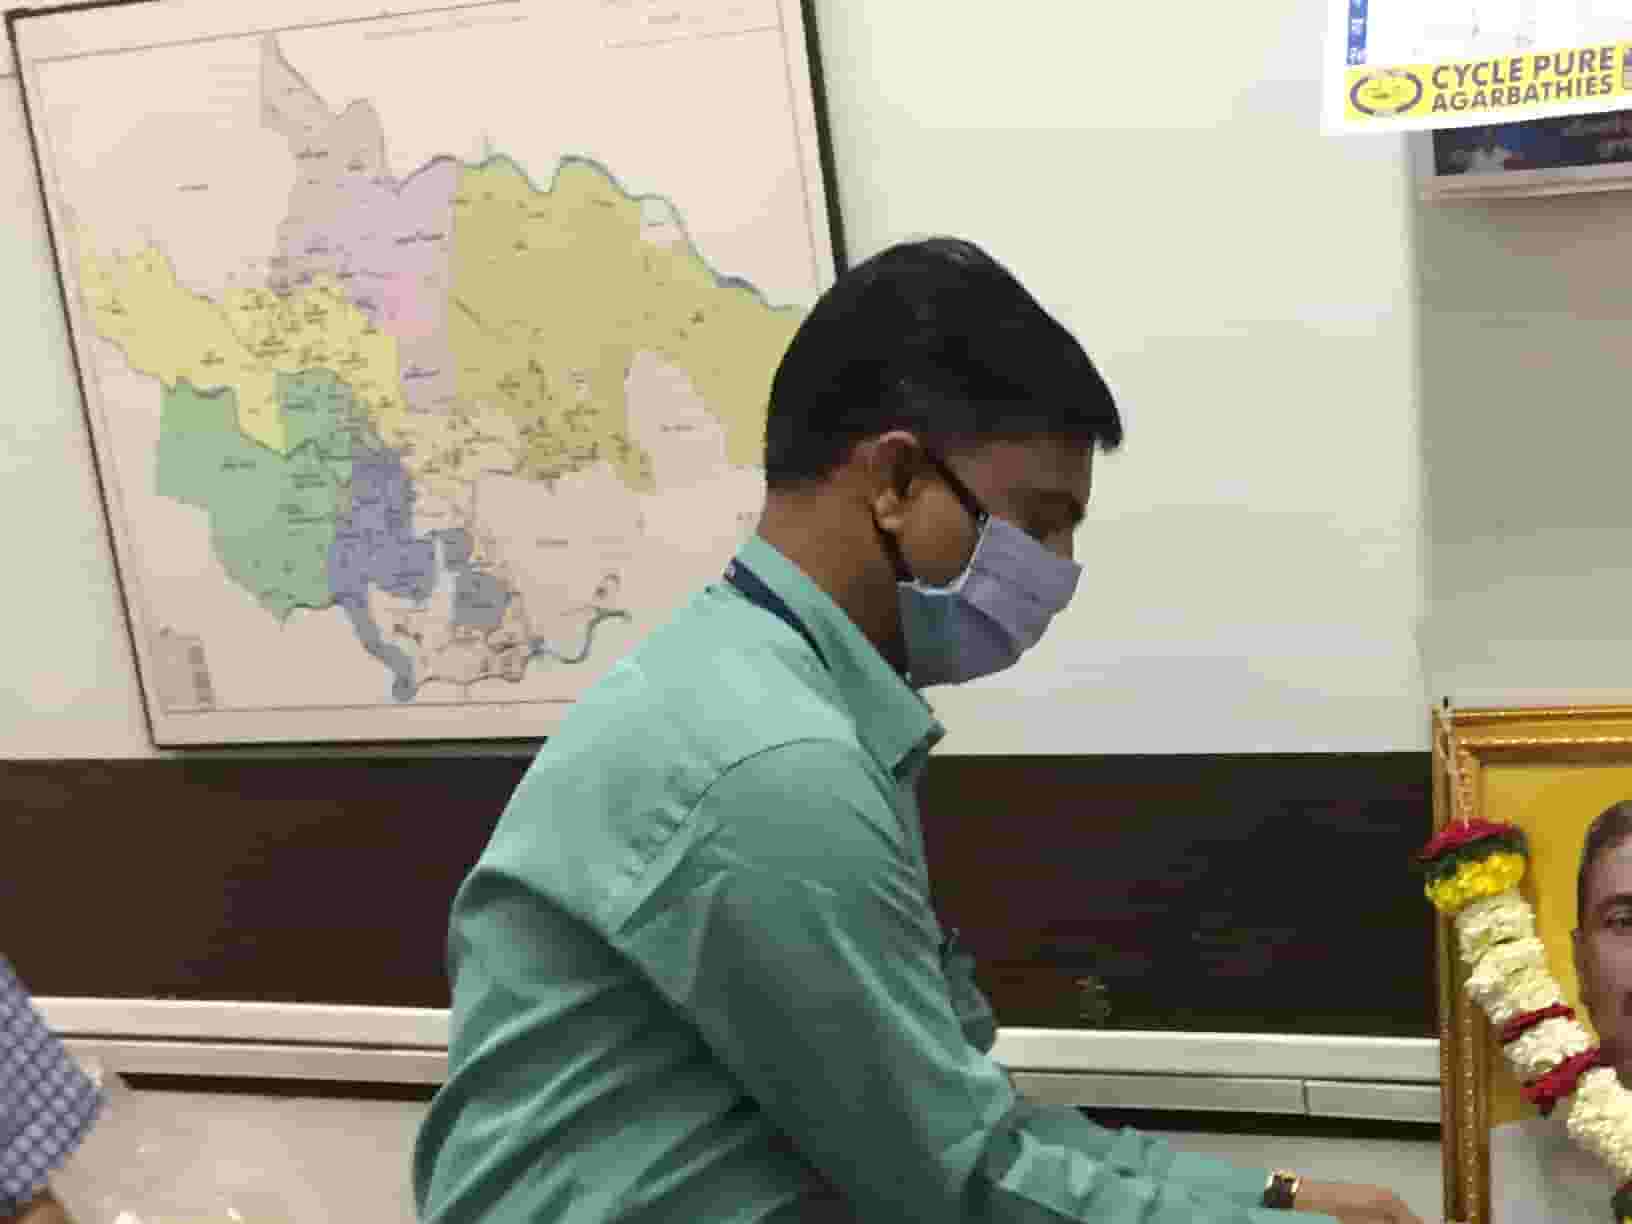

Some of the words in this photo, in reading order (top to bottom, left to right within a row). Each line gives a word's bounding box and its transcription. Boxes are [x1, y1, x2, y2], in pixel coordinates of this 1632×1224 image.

[1432, 57, 1524, 89] CYCLE
[1533, 46, 1616, 80] PURE
[1432, 74, 1613, 112] AGARBATHIES
